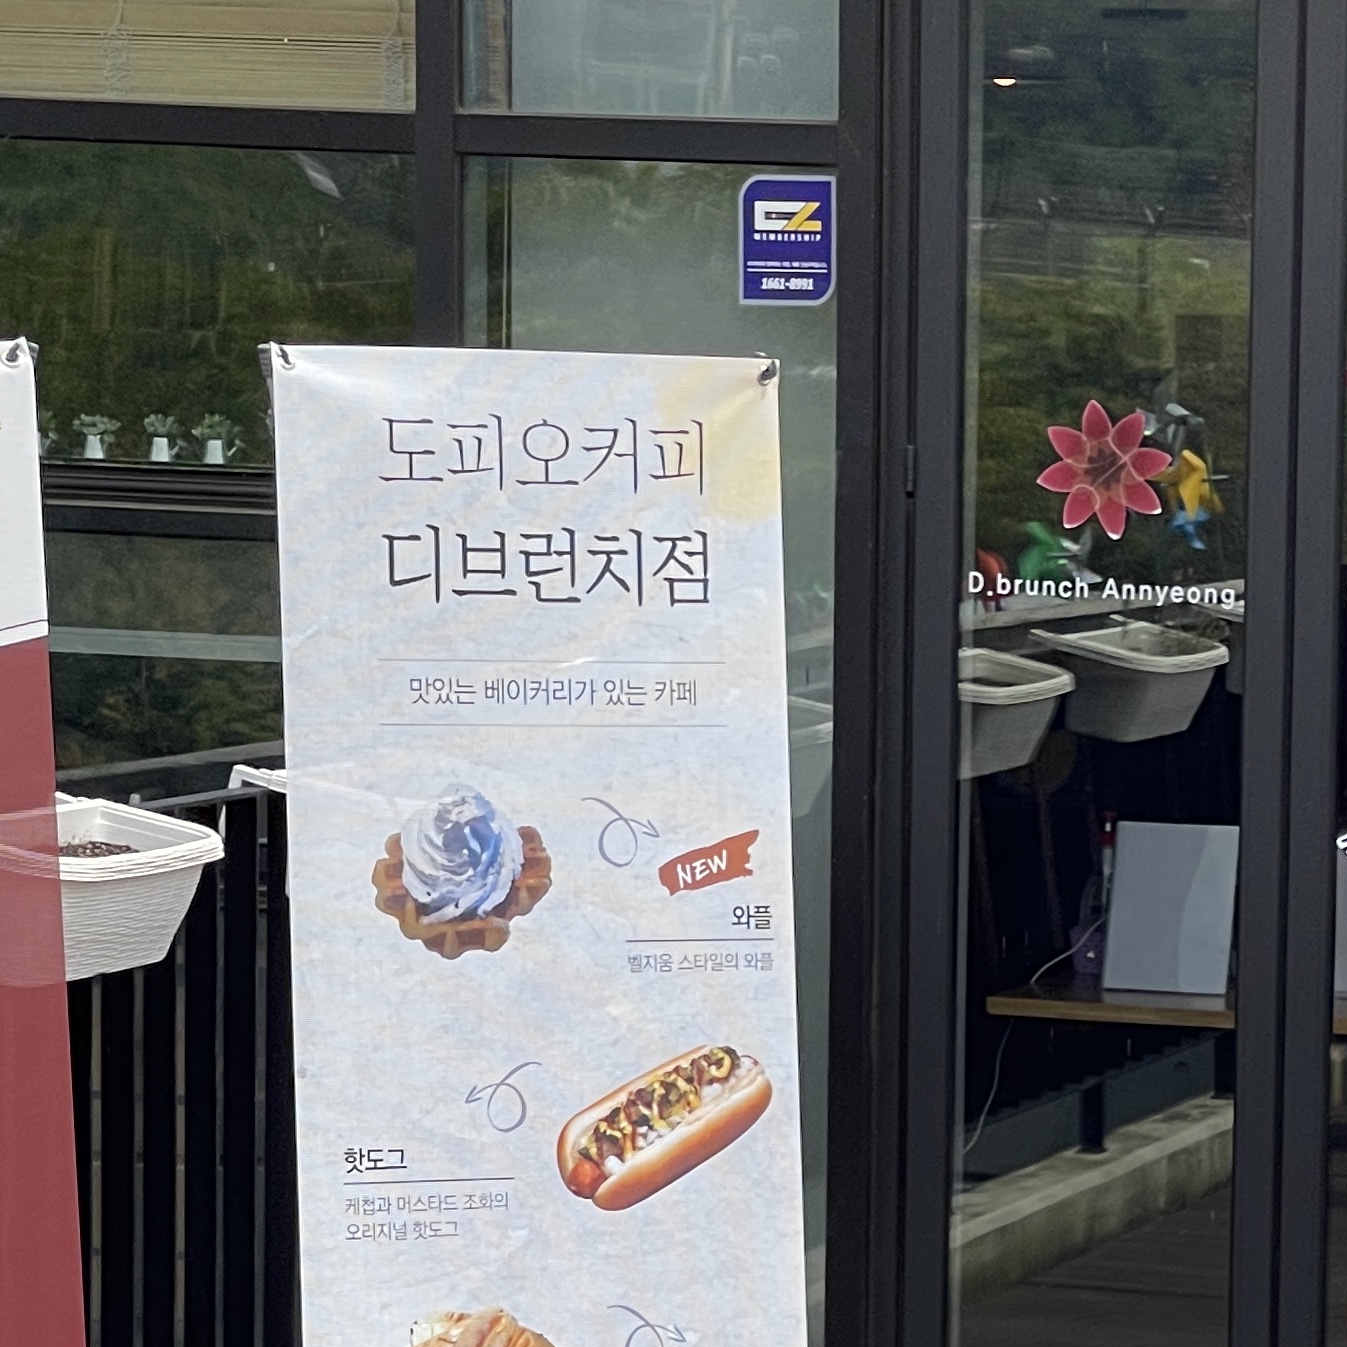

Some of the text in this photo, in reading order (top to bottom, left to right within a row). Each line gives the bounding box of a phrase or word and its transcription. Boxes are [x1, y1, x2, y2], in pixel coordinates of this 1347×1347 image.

[378, 413, 704, 496] 도피오커피
[381, 524, 710, 607] 디브런치점
[967, 571, 1236, 610] D.brunch Annyeong
[409, 678, 697, 707] 맛있는 베이커리가 있는 카페
[676, 849, 727, 889] NEW
[731, 904, 772, 930] 와플
[627, 952, 774, 973] 벨지움 스타일의 와플
[343, 1147, 407, 1174] 핫도그
[345, 1191, 510, 1216] 케첩과 머스타드 조화의
[345, 1220, 460, 1241] 오리지널 핫도그
